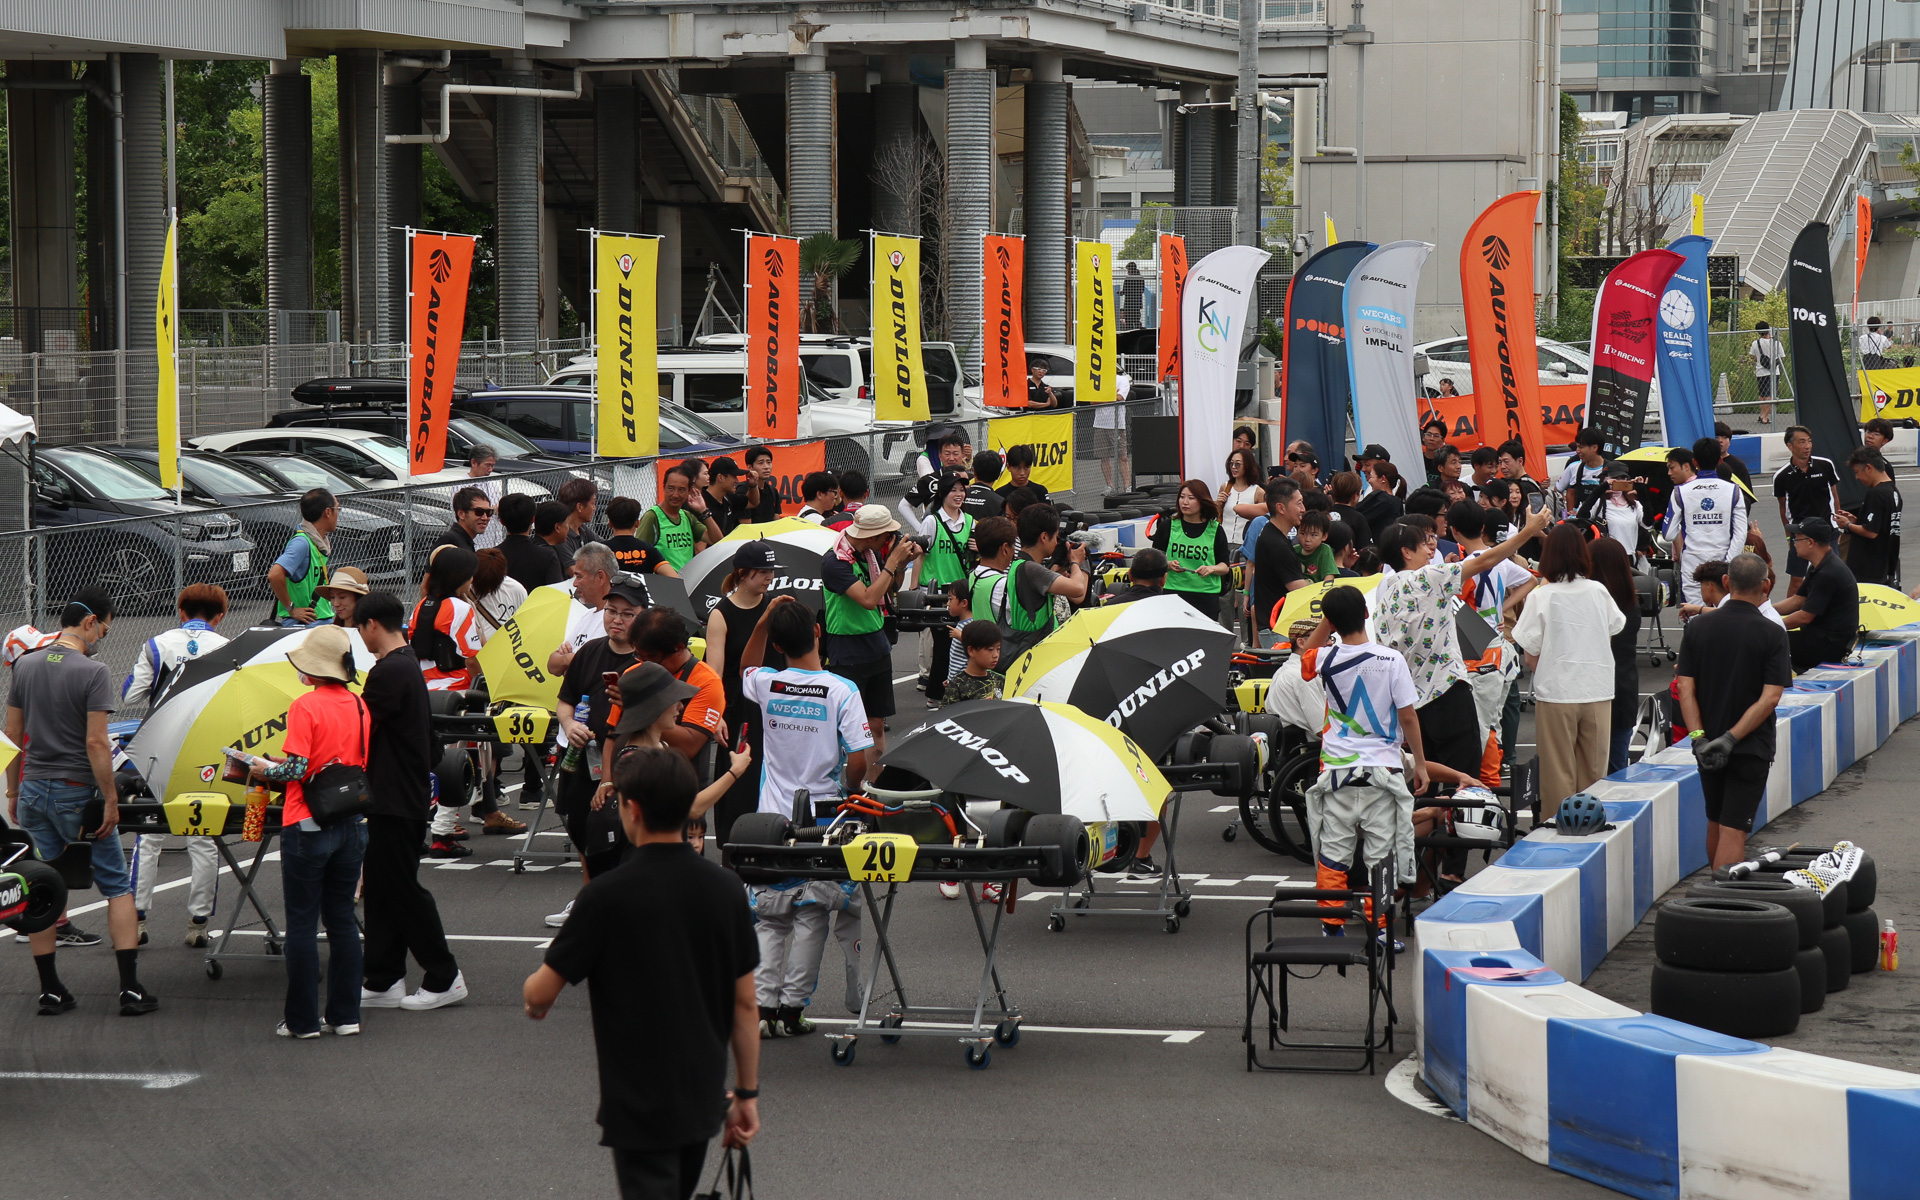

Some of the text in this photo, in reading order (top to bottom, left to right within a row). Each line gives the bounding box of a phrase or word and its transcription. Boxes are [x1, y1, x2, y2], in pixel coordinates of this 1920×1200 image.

[1206, 278, 1242, 295] AUTOBACS
[1369, 276, 1408, 289] AUTOBACS
[1622, 281, 1657, 299] AUTOBACS
[1361, 308, 1402, 324] WECARS
[890, 275, 911, 409] DUNLOP
[1000, 271, 1011, 399] AUTOBACS
[1089, 275, 1104, 392] DUNLOP
[1663, 331, 1693, 343] REALIZE
[766, 278, 780, 430] AUTOBACS
[1366, 337, 1404, 354] IMPUL
[618, 282, 637, 443] DUNLOP
[1489, 271, 1522, 443] AUTOBACS
[1617, 350, 1646, 366] RACING
[415, 284, 441, 463] AUTOBACS
[1030, 440, 1068, 468] NLOP
[666, 532, 692, 549] PRESS
[613, 549, 647, 560] ONOS
[1171, 542, 1209, 562] PRESS
[47, 653, 64, 662] EA7
[785, 685, 824, 696] YOKOHAMA
[1105, 648, 1206, 729] DUNLOP
[1253, 683, 1270, 707] 1
[772, 702, 821, 716] WECARS
[509, 712, 534, 736] 36
[778, 722, 804, 732] ITOCHU
[188, 799, 203, 826] 3
[182, 827, 211, 836] JAF
[861, 840, 896, 871] 20
[863, 873, 896, 882] JAF
